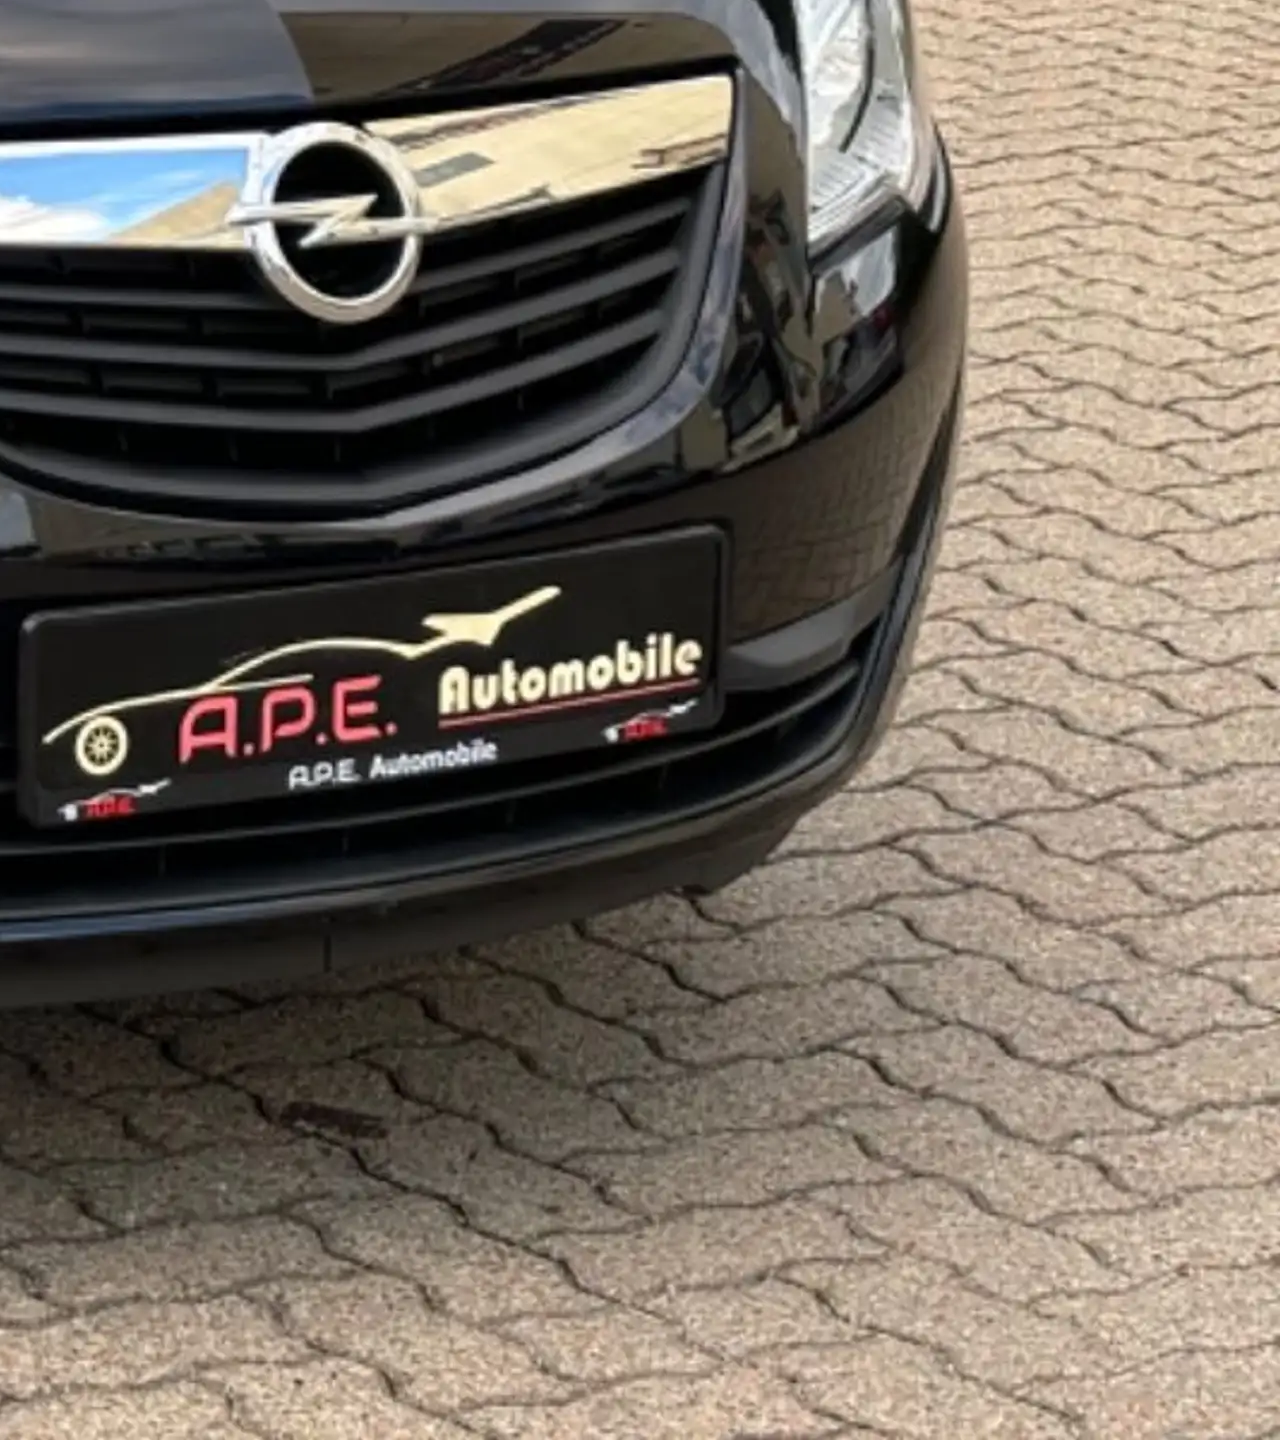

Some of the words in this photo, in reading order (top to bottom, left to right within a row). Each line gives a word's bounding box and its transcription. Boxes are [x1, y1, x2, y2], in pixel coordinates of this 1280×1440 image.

[179, 676, 397, 764] A.P.E.
[440, 633, 703, 715] Automobile
[369, 737, 498, 779] Automobile
